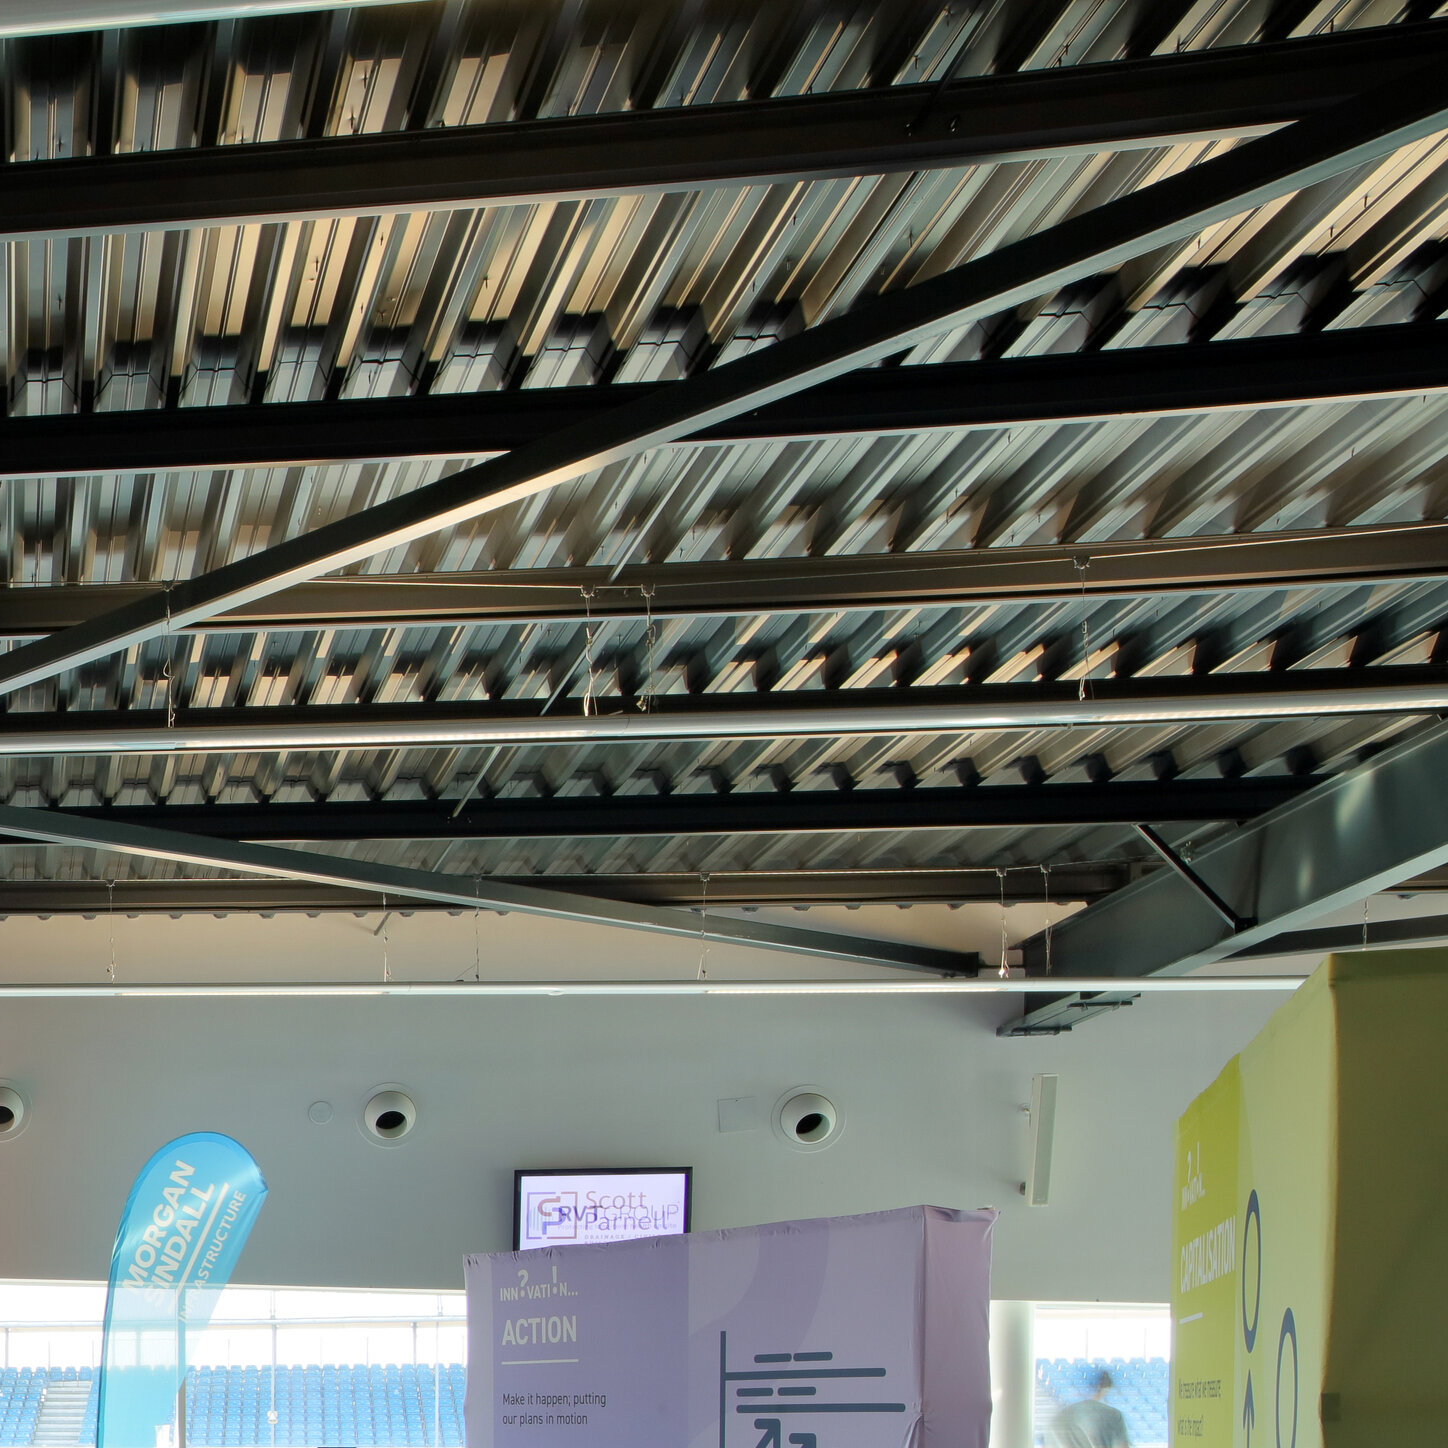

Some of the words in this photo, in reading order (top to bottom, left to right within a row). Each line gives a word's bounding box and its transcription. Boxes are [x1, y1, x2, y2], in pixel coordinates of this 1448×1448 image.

[586, 1191, 647, 1209] Scott
[122, 1160, 195, 1295] MORGAN
[585, 1211, 667, 1231] Parnell
[178, 1190, 247, 1324] INASTRUCTURE
[1181, 1215, 1236, 1294] CAPITALISATION
[502, 1315, 577, 1345] ACTION
[502, 1393, 525, 1405] Make
[527, 1393, 534, 1405] it
[536, 1393, 571, 1407] happen;
[574, 1394, 606, 1407] putting
[503, 1415, 517, 1425] our
[520, 1412, 543, 1427] plans
[546, 1412, 554, 1424] in
[556, 1413, 588, 1425] motion
